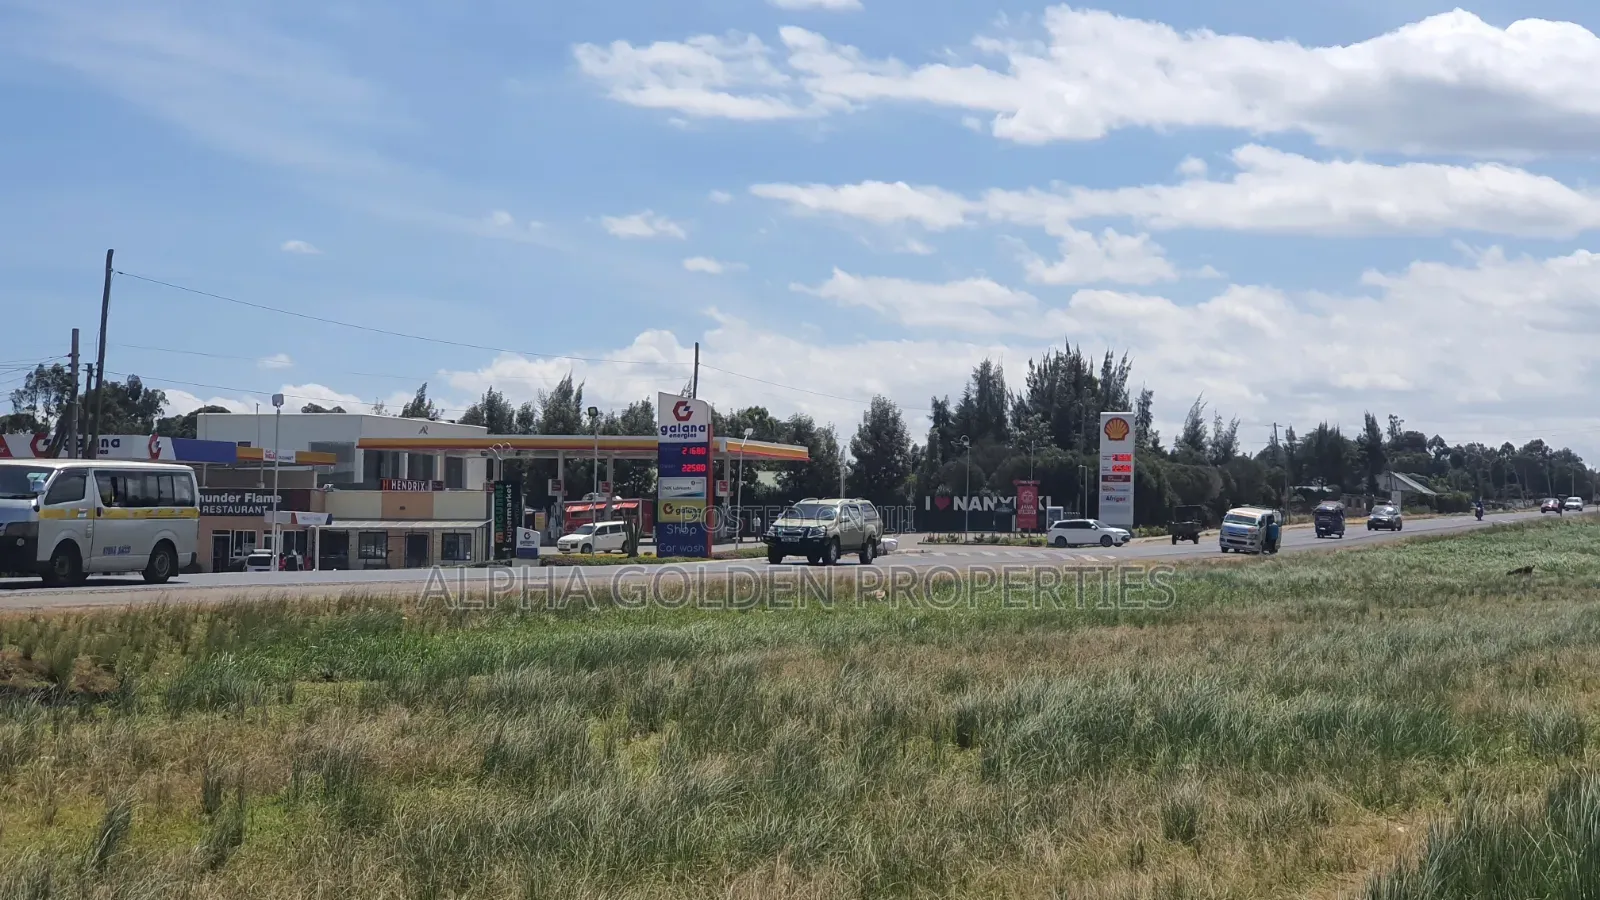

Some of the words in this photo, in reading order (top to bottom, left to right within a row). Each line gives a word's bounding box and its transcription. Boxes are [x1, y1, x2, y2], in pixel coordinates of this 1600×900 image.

[660, 423, 706, 436] galana
[392, 480, 425, 492] HENDRIX
[199, 492, 242, 502] hunder
[244, 492, 282, 502] Flame
[925, 496, 930, 510] I
[954, 496, 1052, 511] NANYKI
[202, 506, 268, 514] RESTAURANT
[666, 524, 697, 536] Shop
[660, 542, 676, 552] Car
[680, 543, 705, 552] wash
